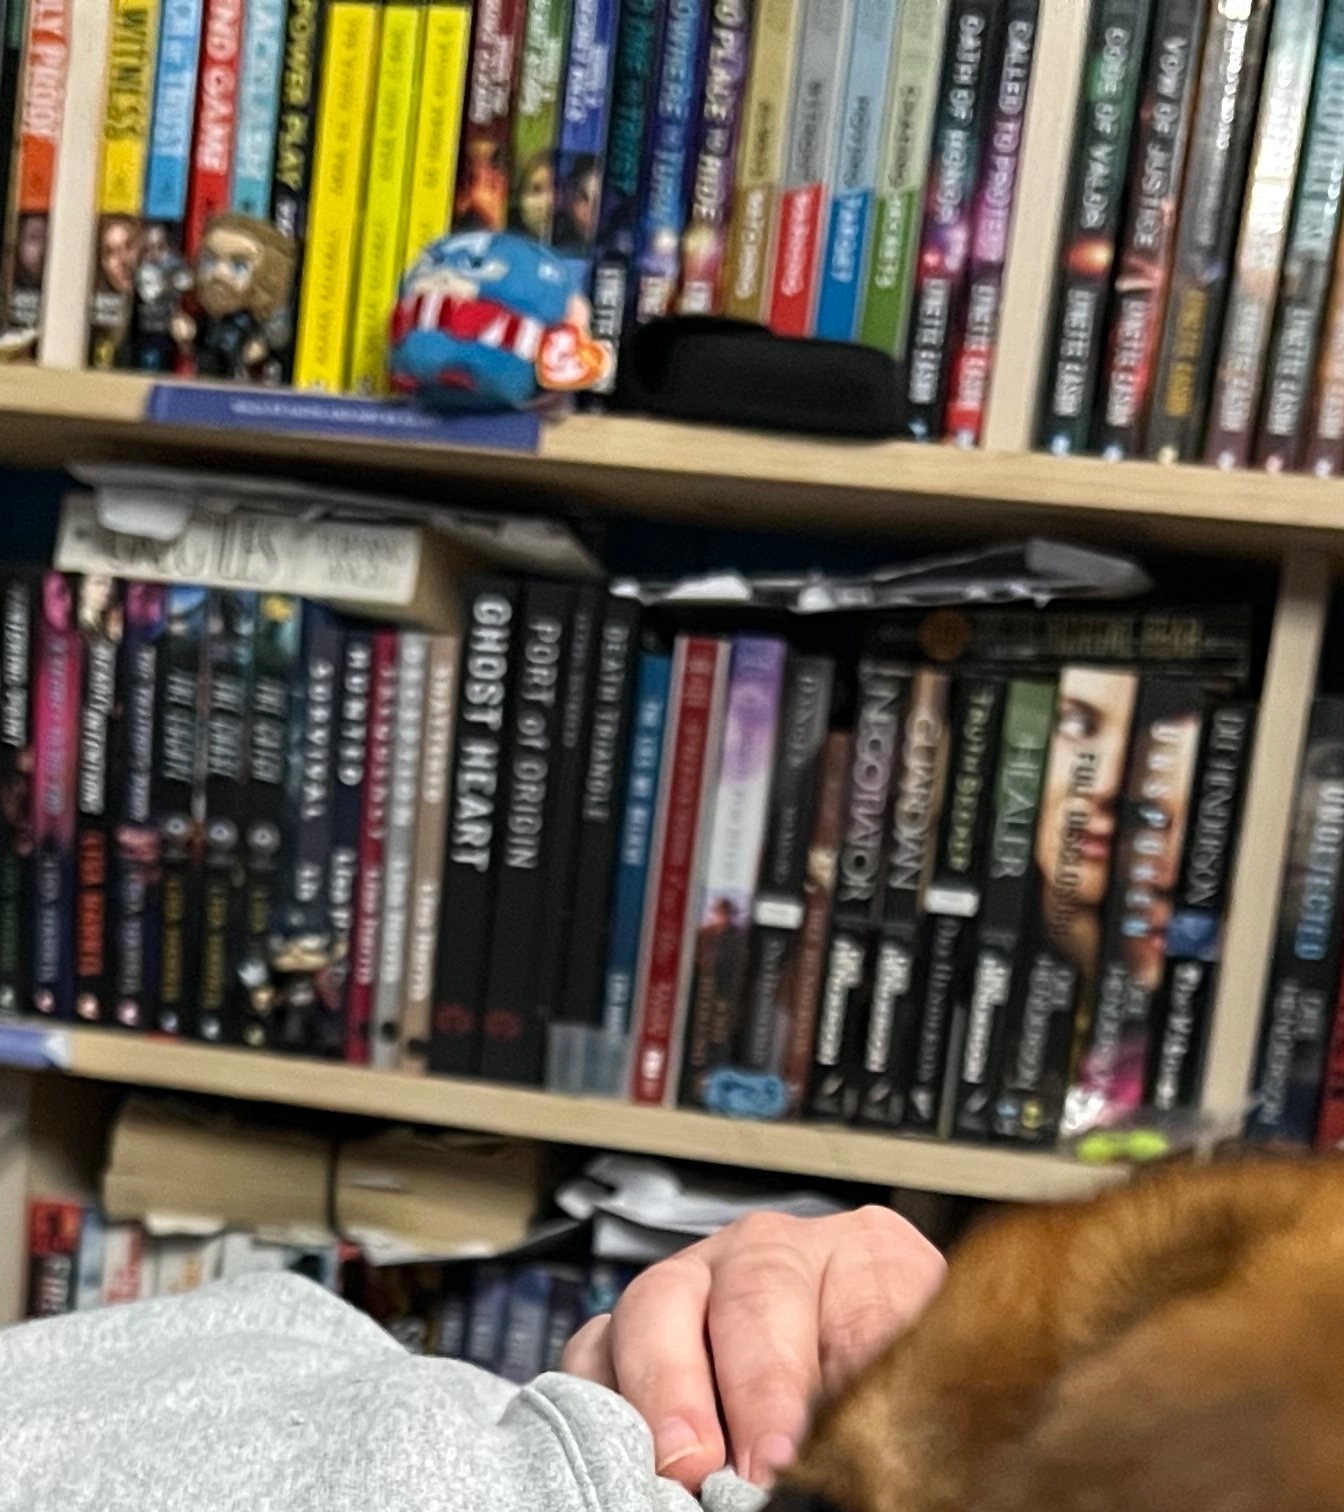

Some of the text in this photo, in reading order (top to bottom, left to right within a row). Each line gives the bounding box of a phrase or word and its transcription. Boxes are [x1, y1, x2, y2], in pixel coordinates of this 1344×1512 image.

[106, 9, 150, 140] WITNESS
[195, 64, 237, 175] GAME
[663, 0, 697, 122] OWHERE
[275, 112, 304, 192] PLAY
[1130, 142, 1173, 248] JUSTICE
[337, 644, 371, 785] HUNTED
[518, 618, 562, 707] PORT
[582, 624, 629, 822] DEATH TRIANGLE
[450, 594, 513, 873] GHOST HEART
[1069, 747, 1098, 793] FULL
[506, 759, 544, 870] ORIGIN
[1122, 719, 1182, 938] UNSPOKEN
[1185, 753, 1241, 905] HENDERSON
